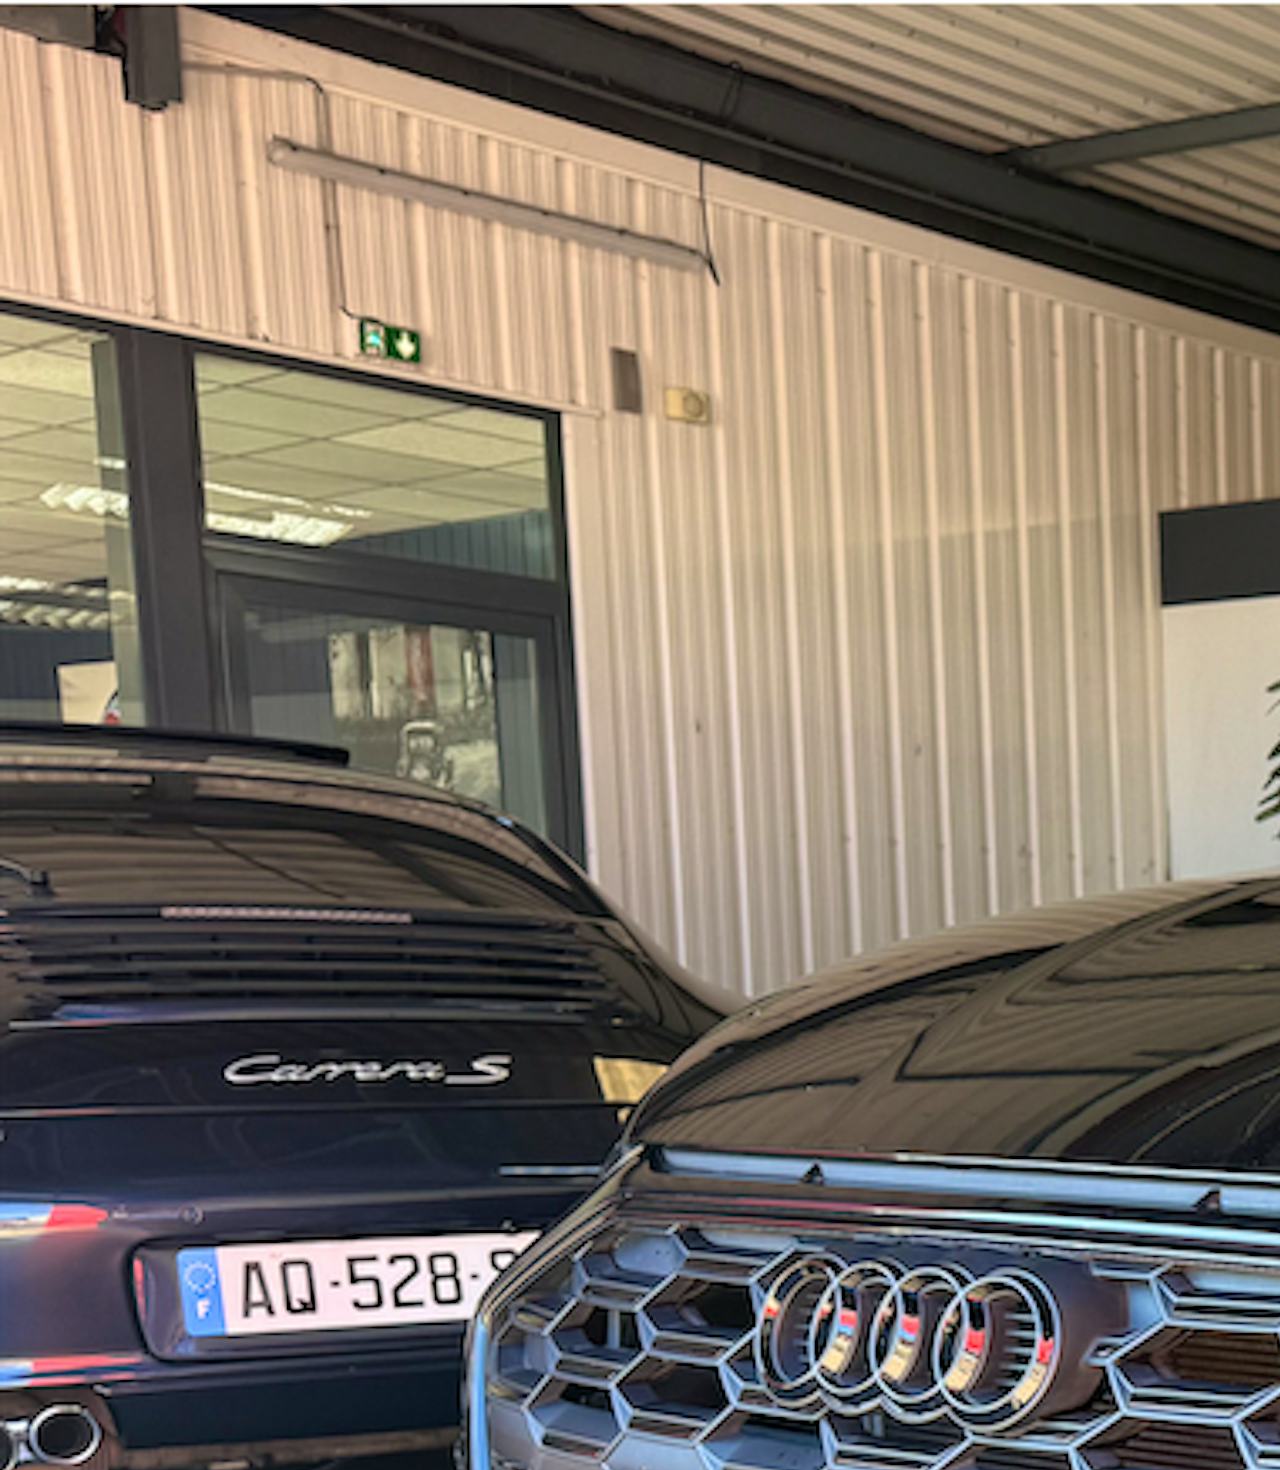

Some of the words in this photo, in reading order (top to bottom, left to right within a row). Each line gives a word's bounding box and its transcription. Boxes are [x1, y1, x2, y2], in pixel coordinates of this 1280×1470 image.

[224, 1055, 446, 1085] Carrera
[445, 1055, 512, 1085] S
[196, 1299, 211, 1320] F
